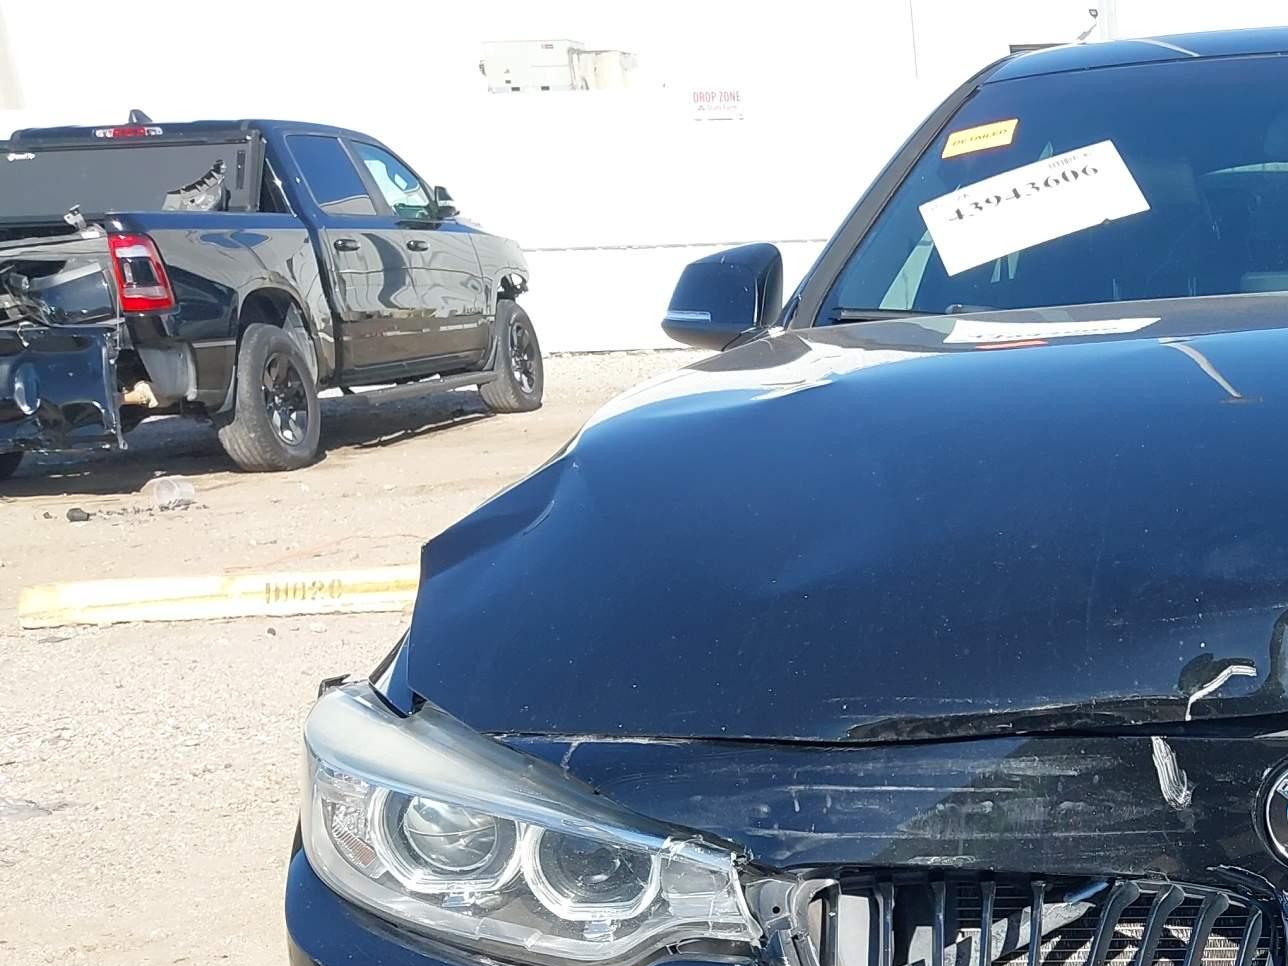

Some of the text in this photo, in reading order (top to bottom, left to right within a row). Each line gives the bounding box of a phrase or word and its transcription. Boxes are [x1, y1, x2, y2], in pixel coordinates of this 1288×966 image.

[692, 90, 741, 103] DROP ZONE
[947, 164, 1099, 221] 43943606
